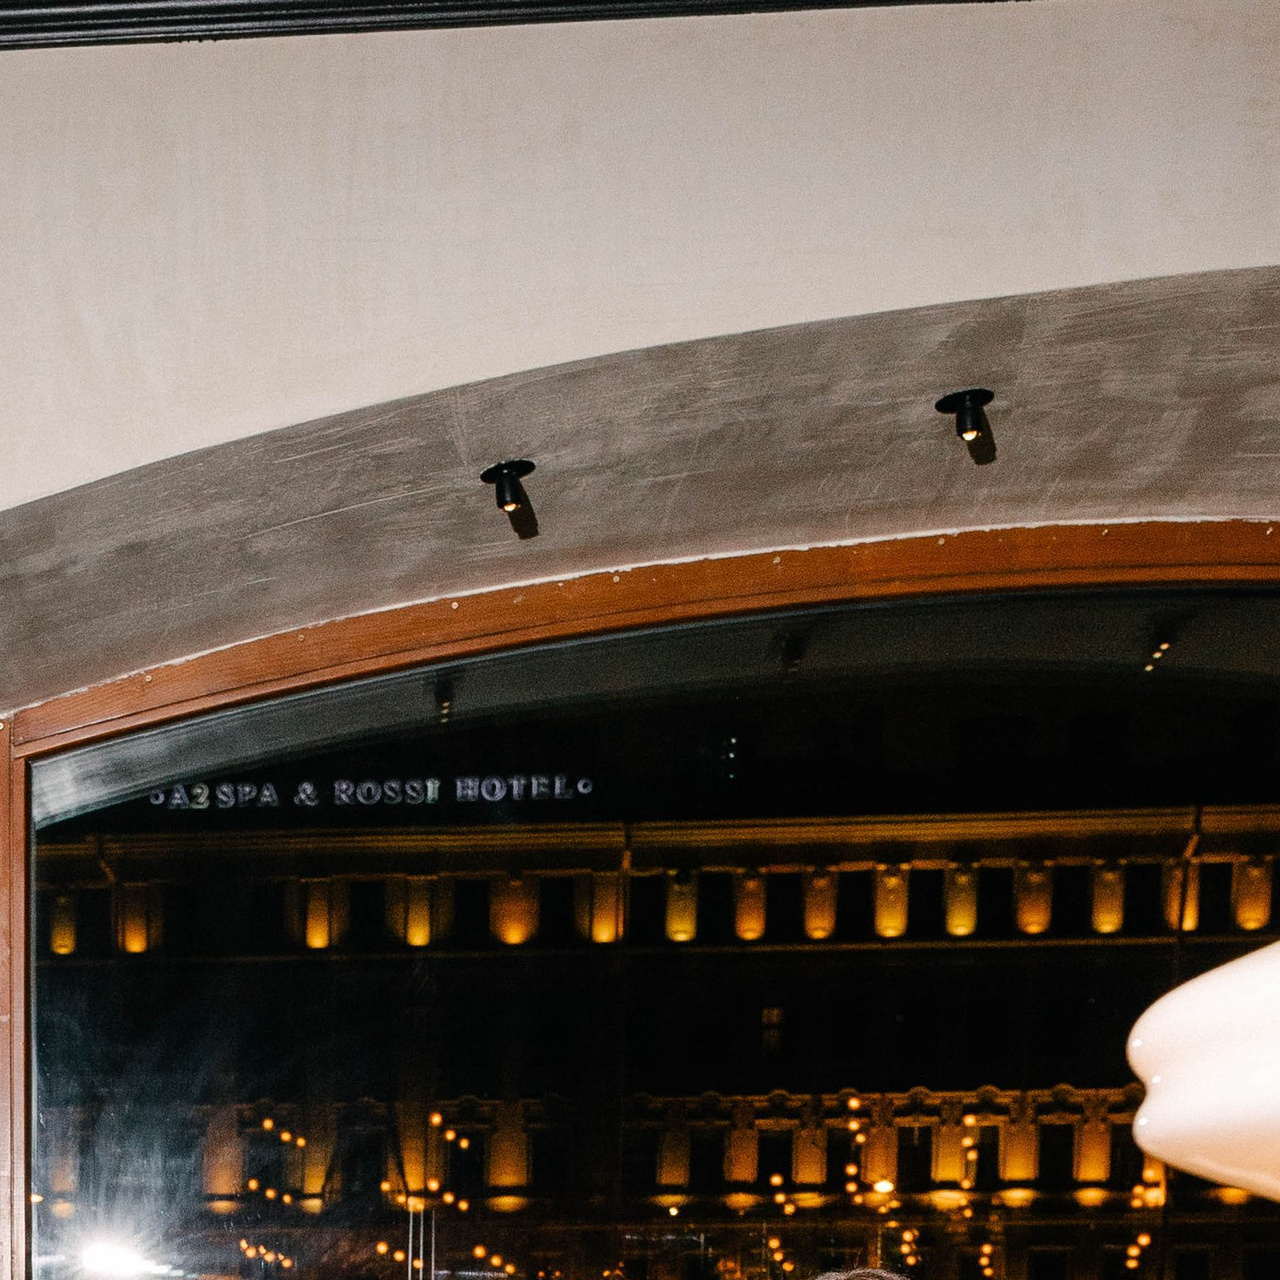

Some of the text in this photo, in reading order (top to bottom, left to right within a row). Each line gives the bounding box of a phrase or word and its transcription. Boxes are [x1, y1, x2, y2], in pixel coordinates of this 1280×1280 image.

[293, 780, 319, 806] &
[333, 777, 441, 806] ROSSI
[454, 774, 573, 802] HOTEL
